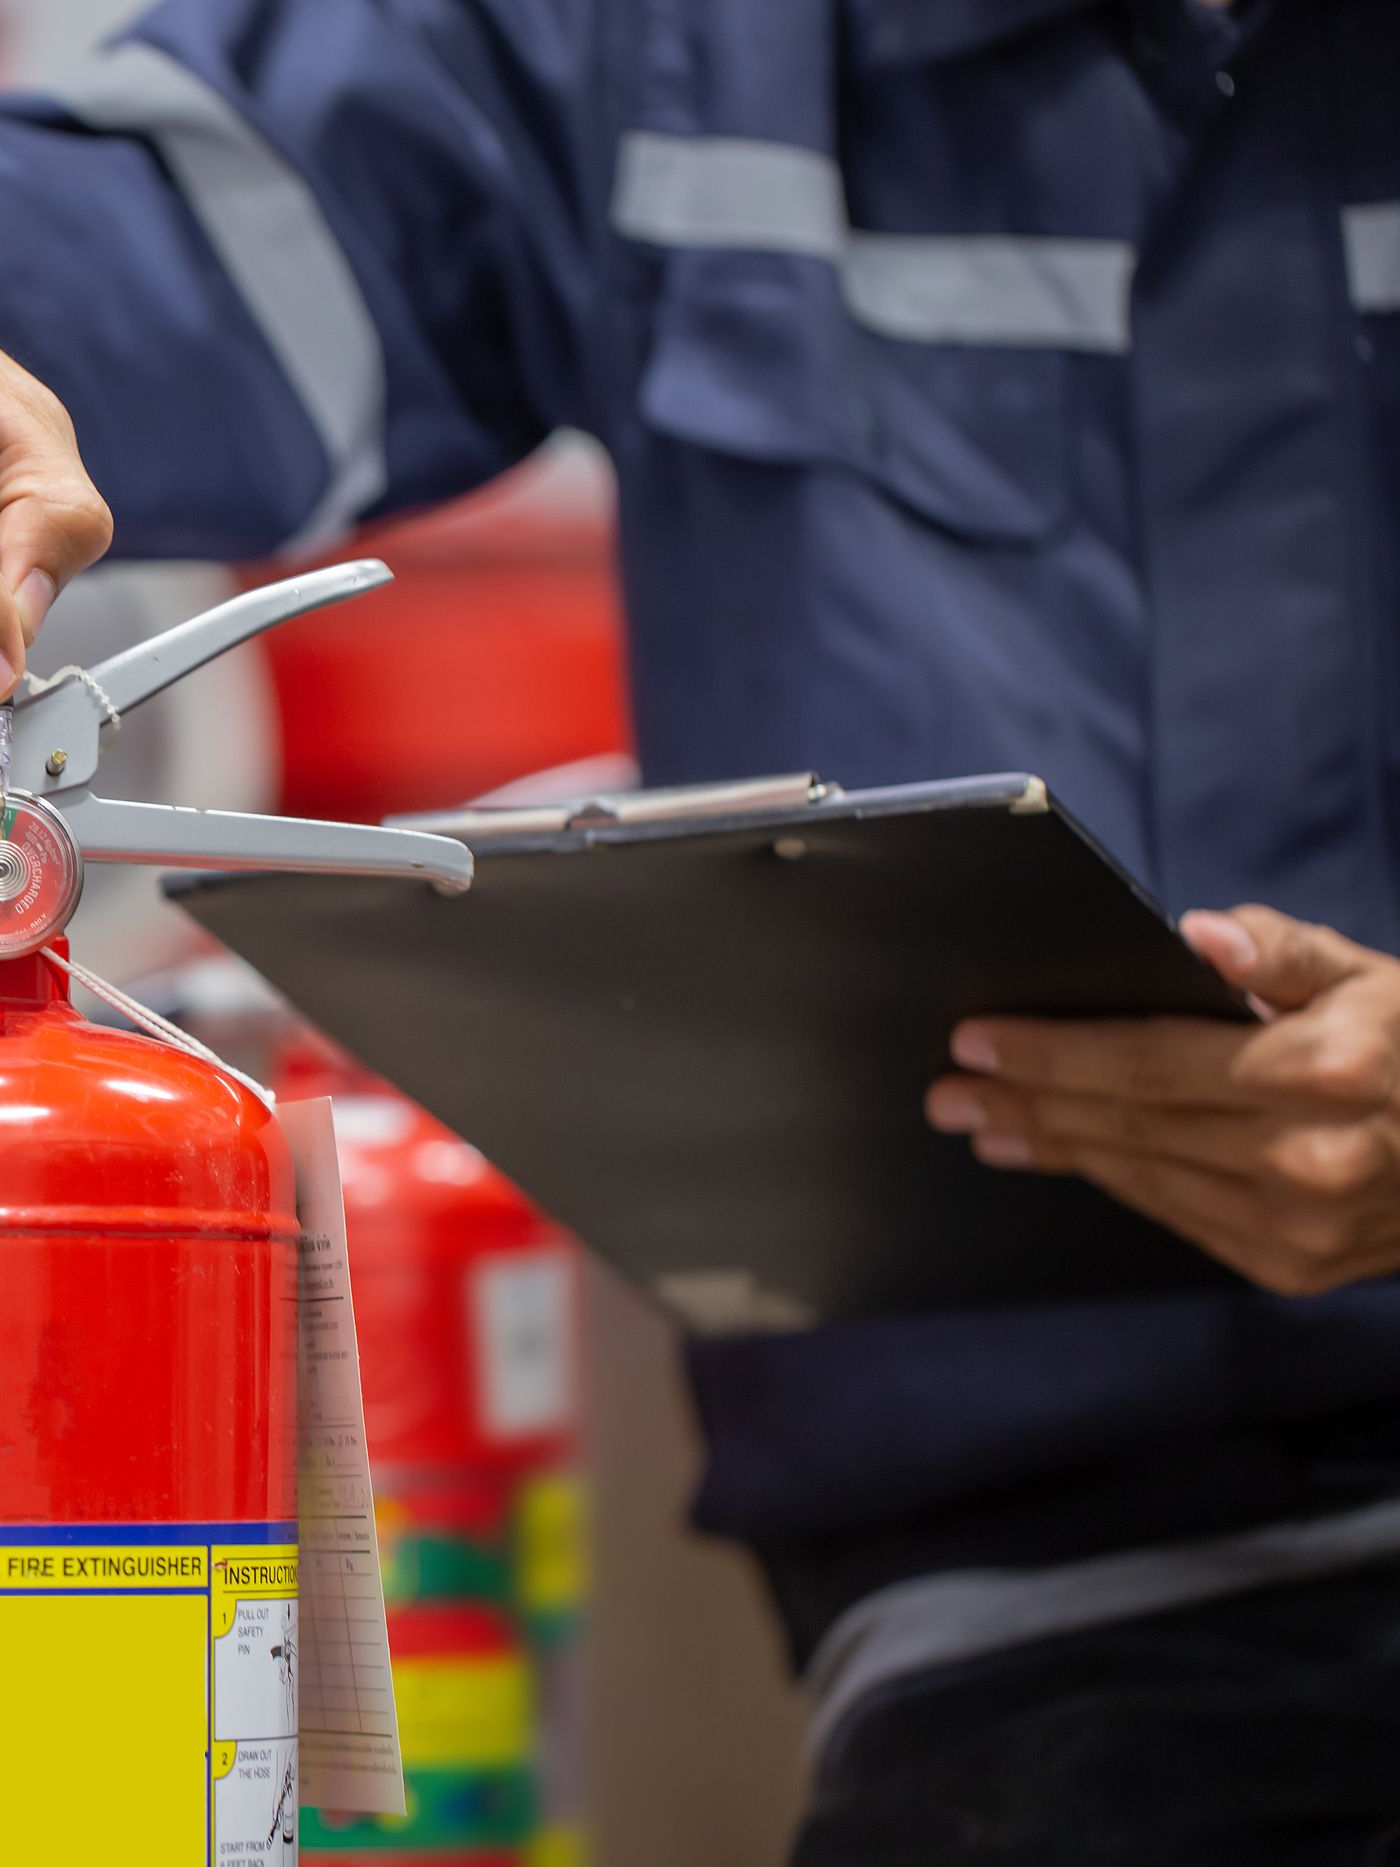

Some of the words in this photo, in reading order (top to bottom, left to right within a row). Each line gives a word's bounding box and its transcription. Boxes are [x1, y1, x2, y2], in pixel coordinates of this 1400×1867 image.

[15, 842, 43, 914] OVERCHARGED
[8, 1557, 54, 1577] FIRE
[63, 1556, 201, 1576] EXTINGUISHER
[222, 1613, 226, 1625] 1
[238, 1609, 254, 1619] PULL
[257, 1608, 269, 1619] OUT
[238, 1626, 264, 1637] SAFETY
[238, 1645, 250, 1655] PIN
